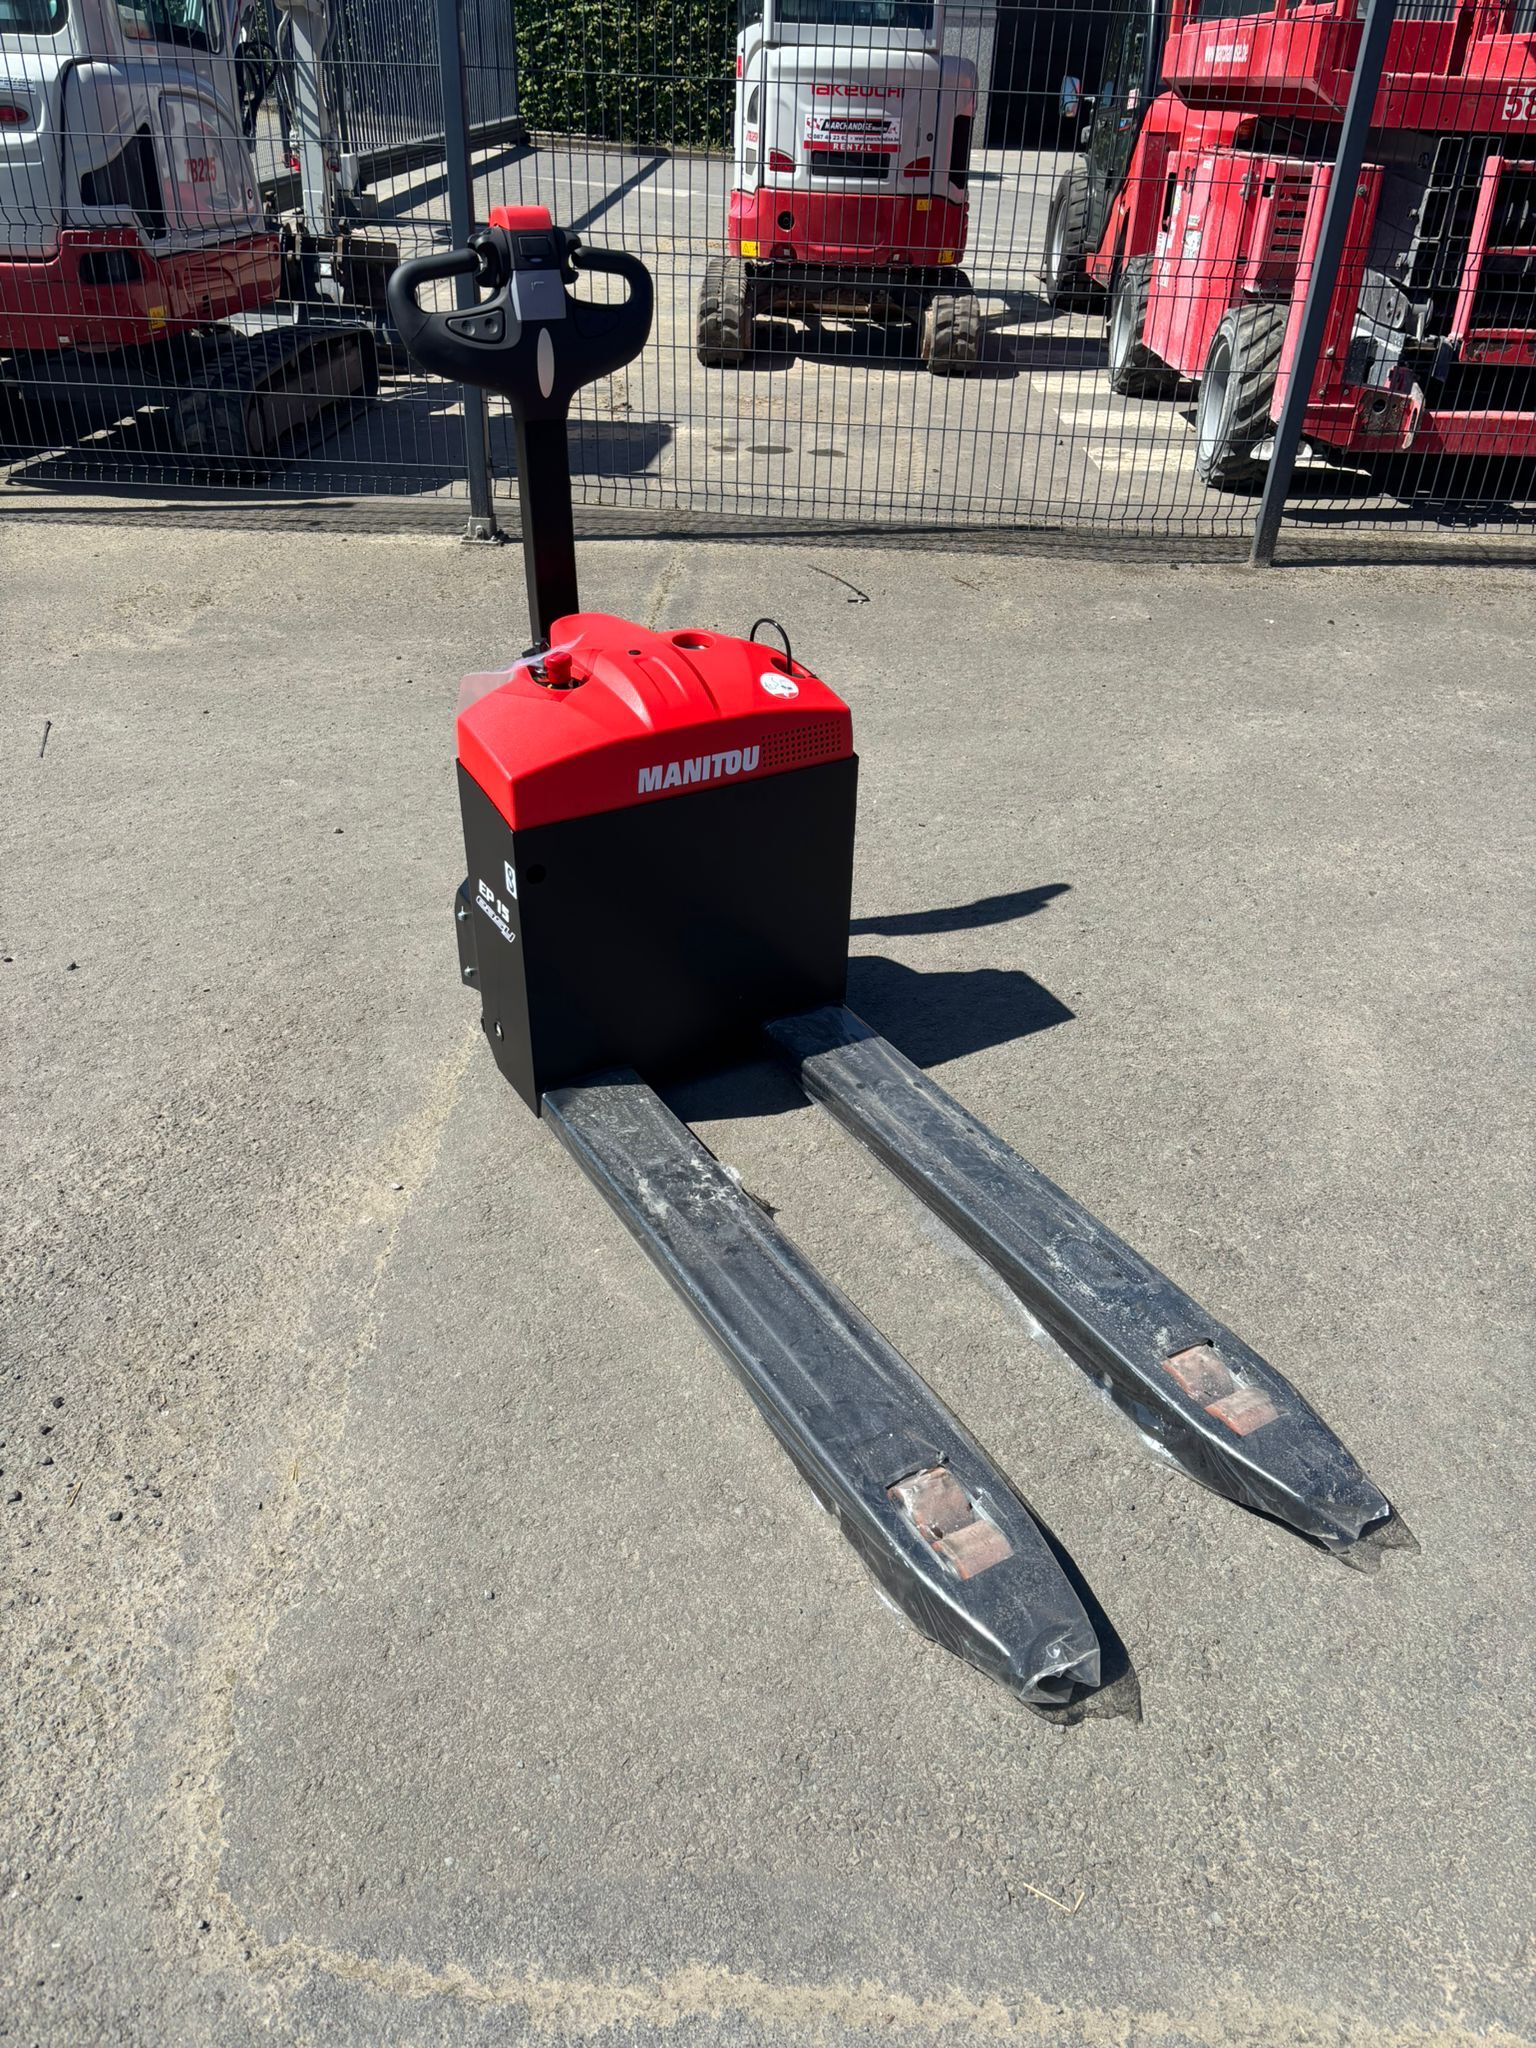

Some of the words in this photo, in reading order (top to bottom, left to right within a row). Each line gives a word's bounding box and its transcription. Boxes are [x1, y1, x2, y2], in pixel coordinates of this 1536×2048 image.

[833, 143, 872, 151] RENTAL
[638, 745, 760, 794] MANITOU
[479, 878, 495, 902] EP
[497, 899, 509, 923] 15
